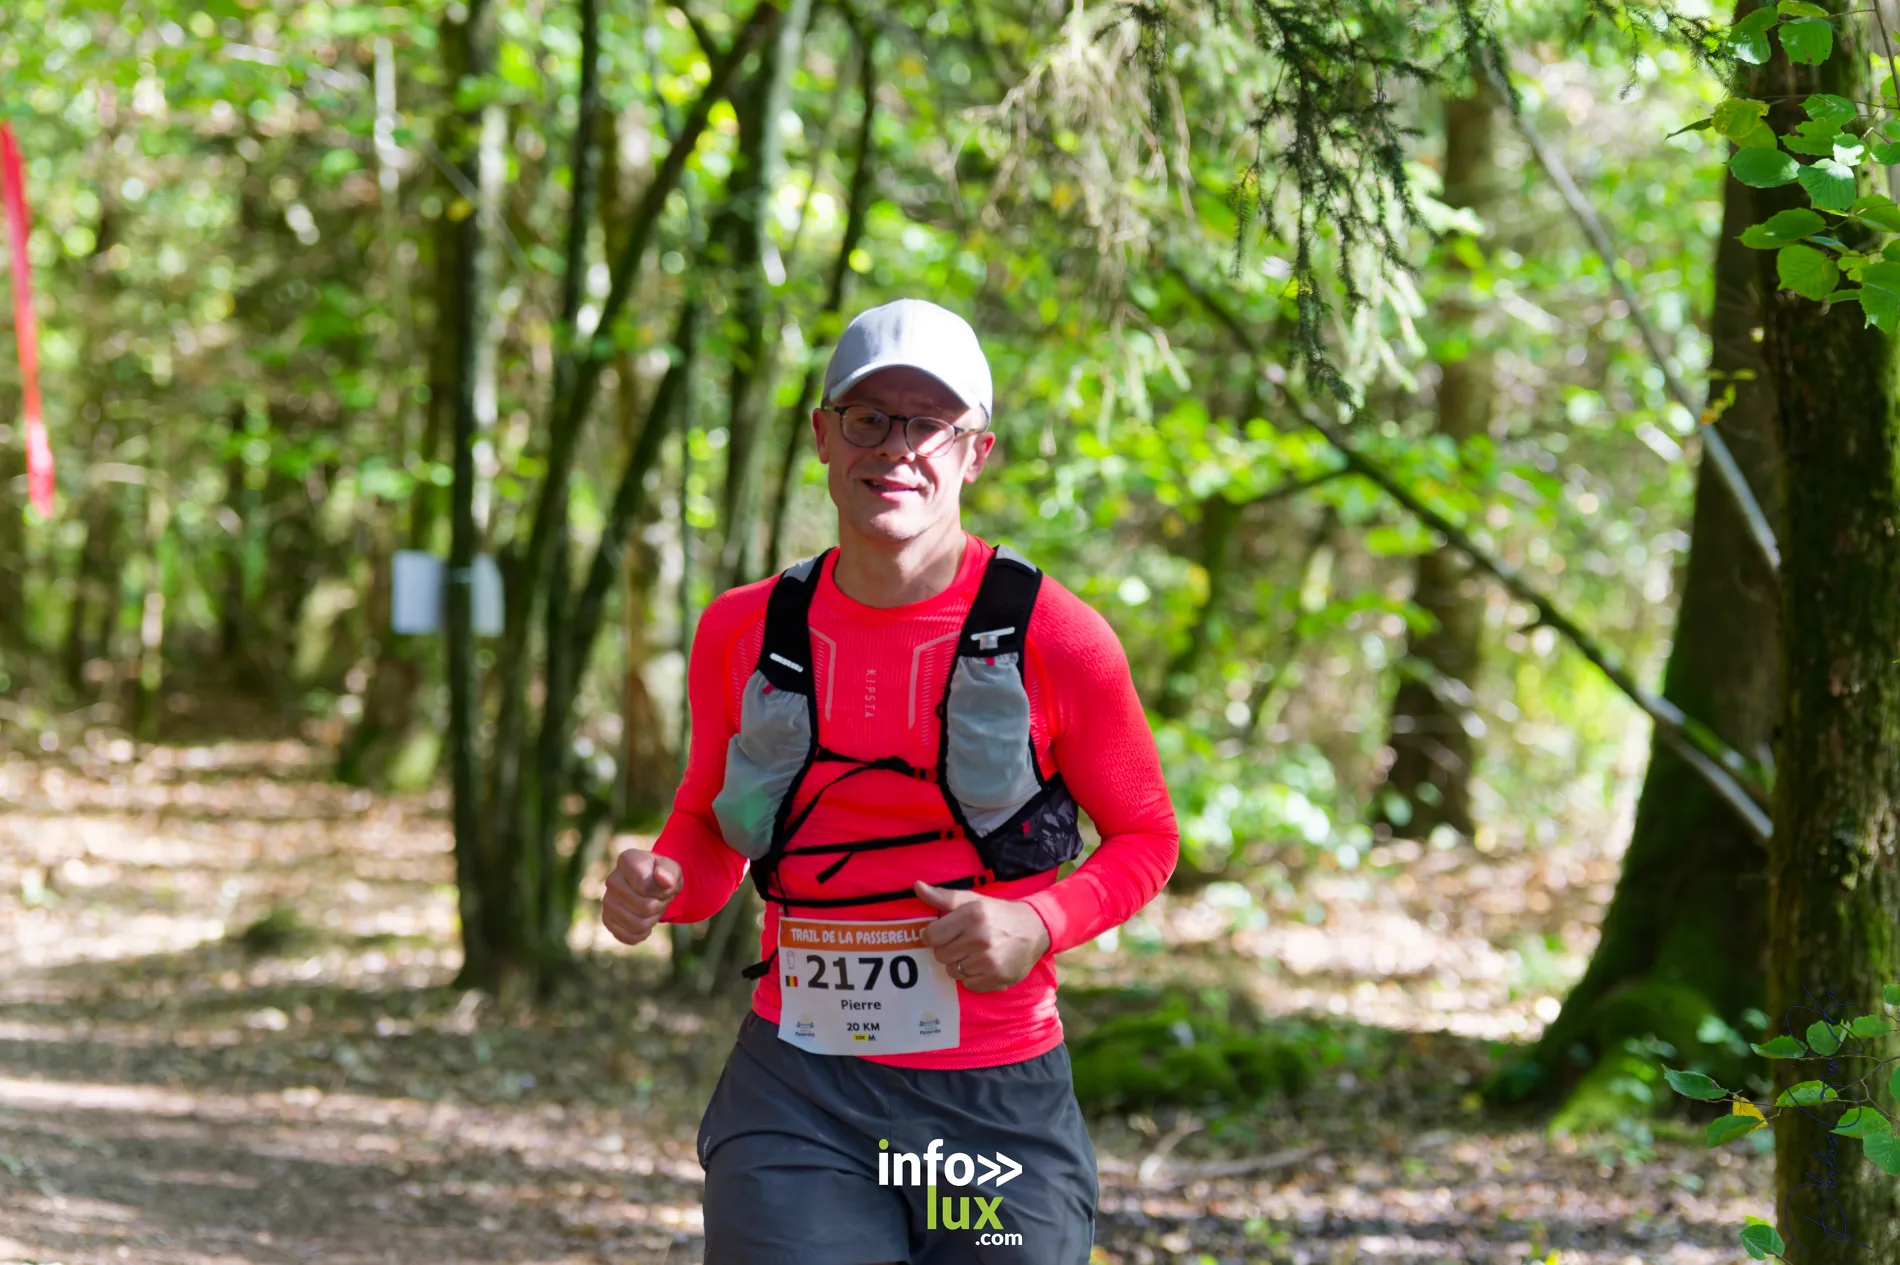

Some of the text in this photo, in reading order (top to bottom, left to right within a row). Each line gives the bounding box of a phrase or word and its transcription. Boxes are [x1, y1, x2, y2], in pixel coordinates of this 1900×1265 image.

[864, 668, 877, 718] KIPSTA
[790, 927, 820, 943] TRAIL
[822, 930, 836, 944] DE
[838, 931, 854, 944] LA
[806, 955, 919, 991] 2170
[841, 999, 882, 1010] Pierre
[846, 1022, 880, 1032] 20 KM
